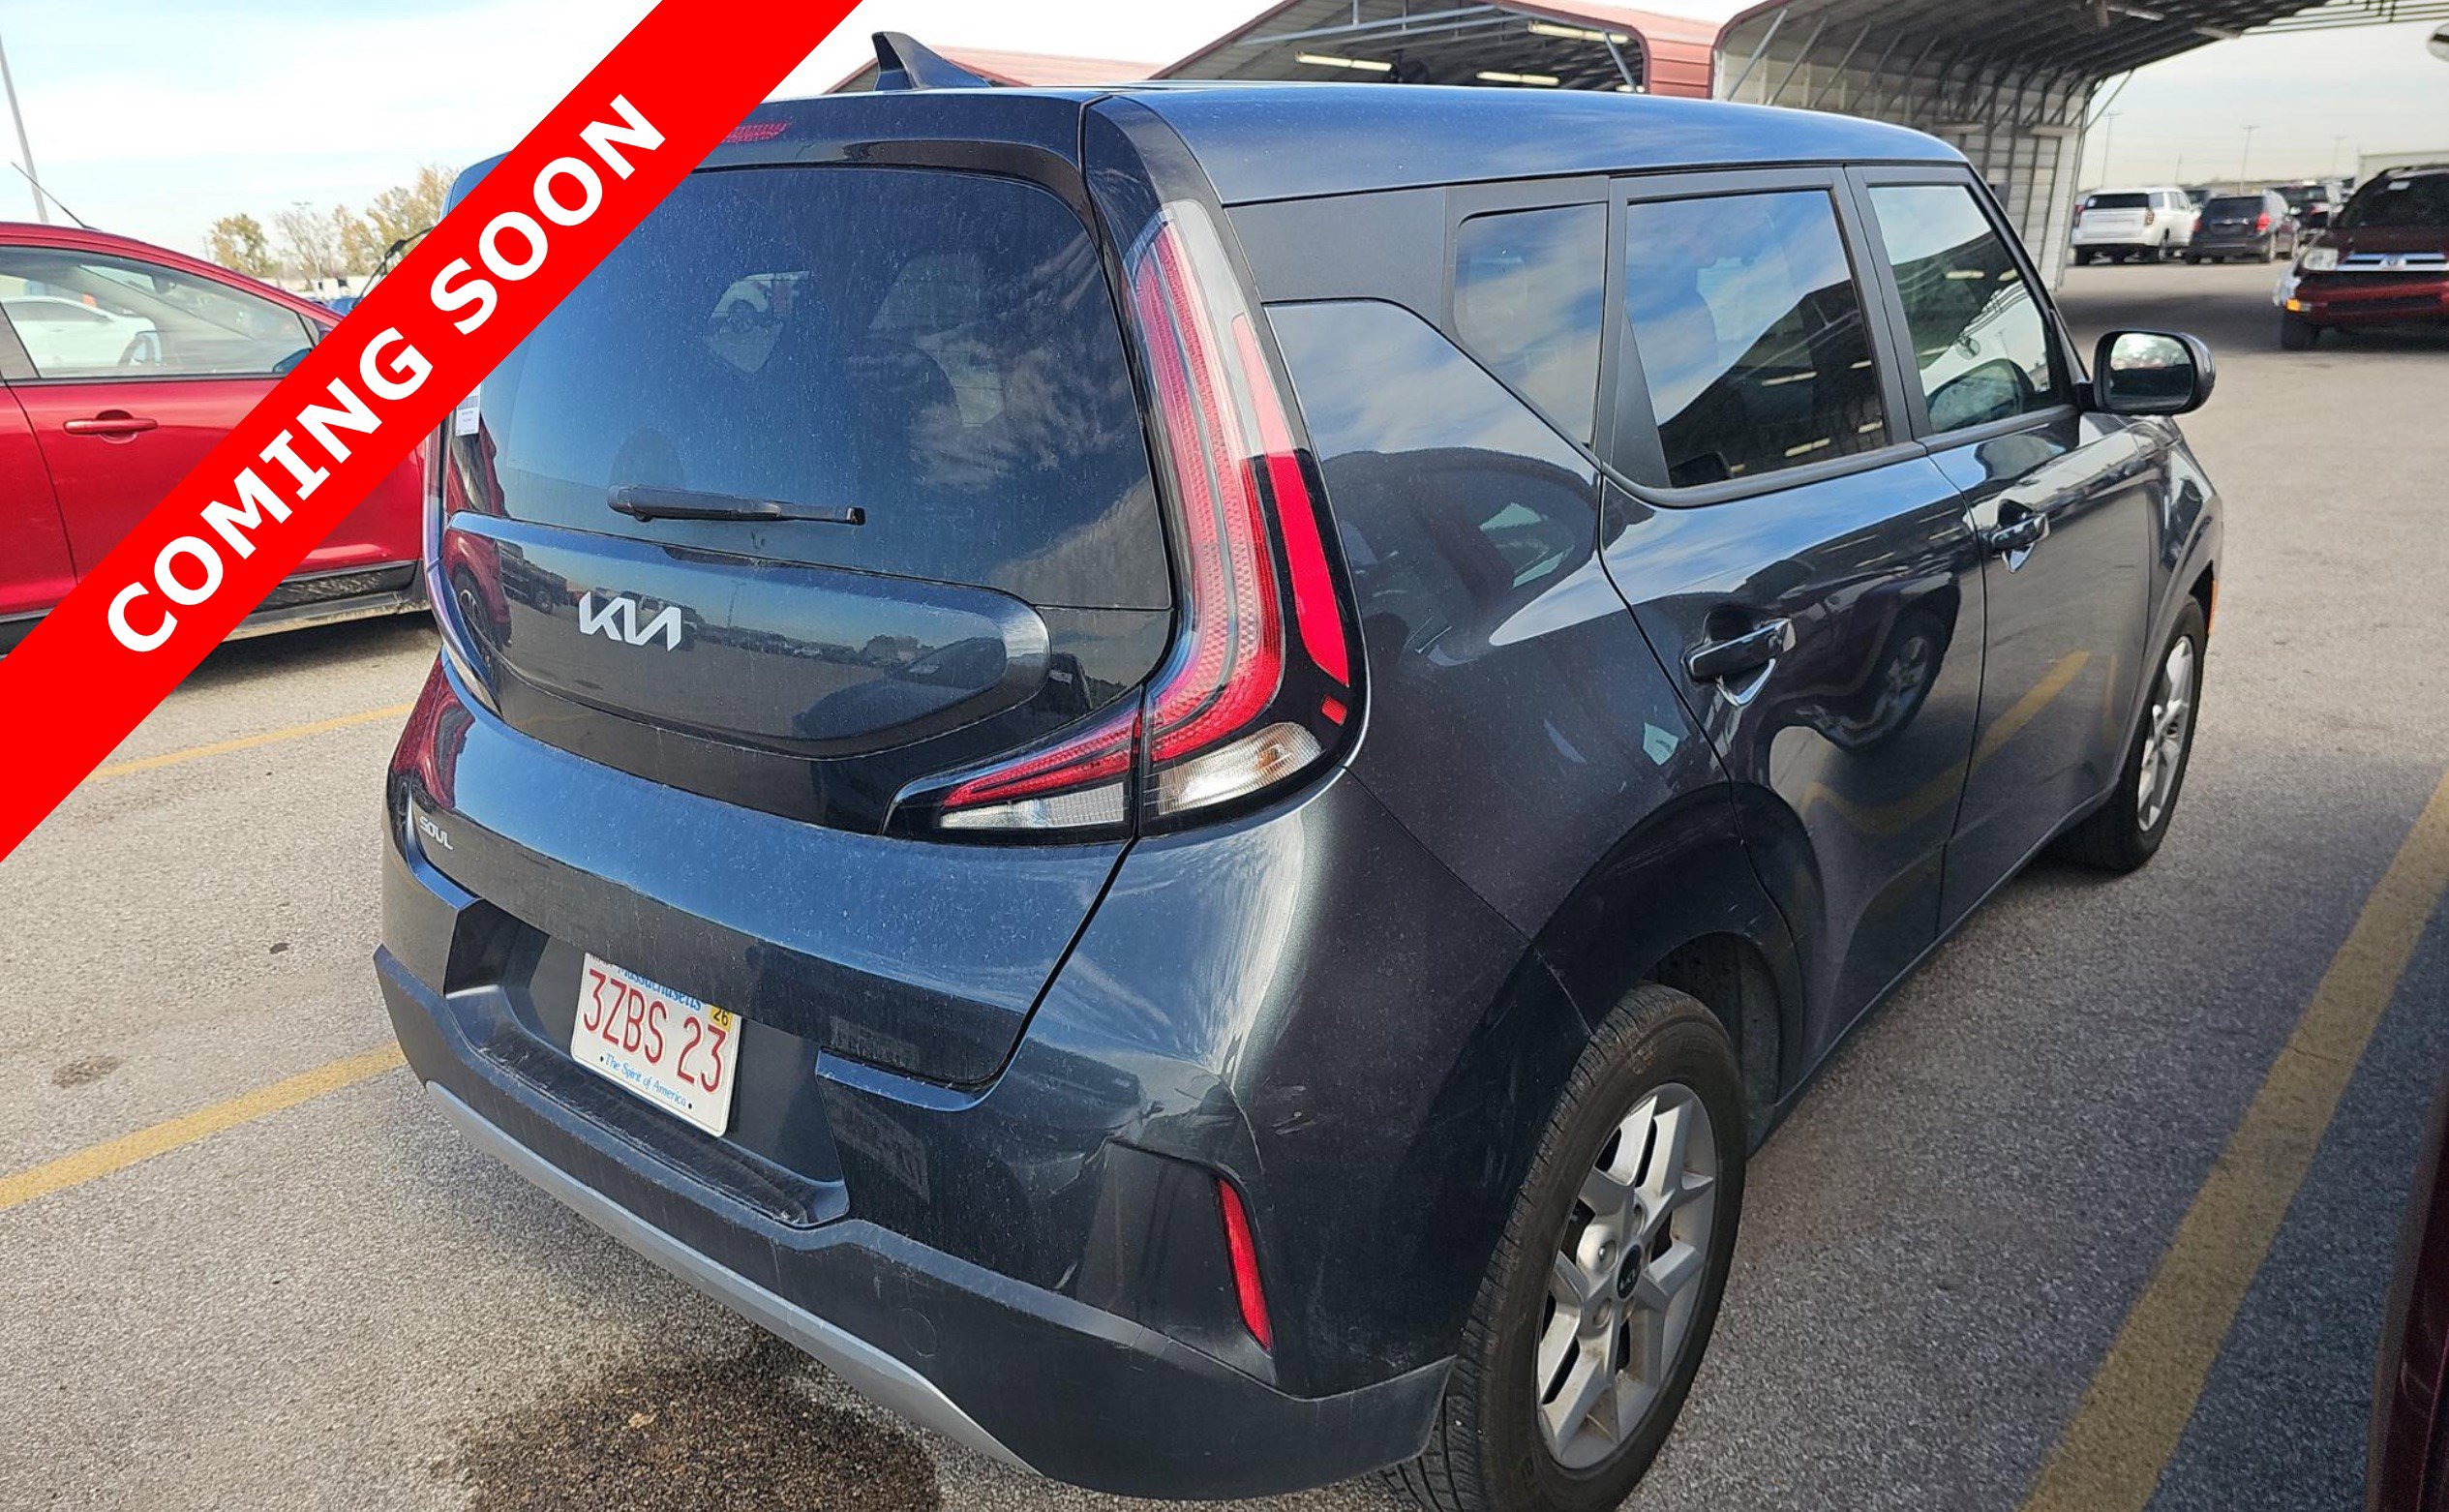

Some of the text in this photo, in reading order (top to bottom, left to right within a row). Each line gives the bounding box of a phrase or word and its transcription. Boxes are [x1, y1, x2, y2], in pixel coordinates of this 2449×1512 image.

[579, 591, 681, 651] KIA
[419, 816, 454, 850] SOUL
[584, 968, 726, 1092] 3ZBS 23
[713, 1009, 729, 1026] 26
[606, 1052, 686, 1106] The Spirit of America
